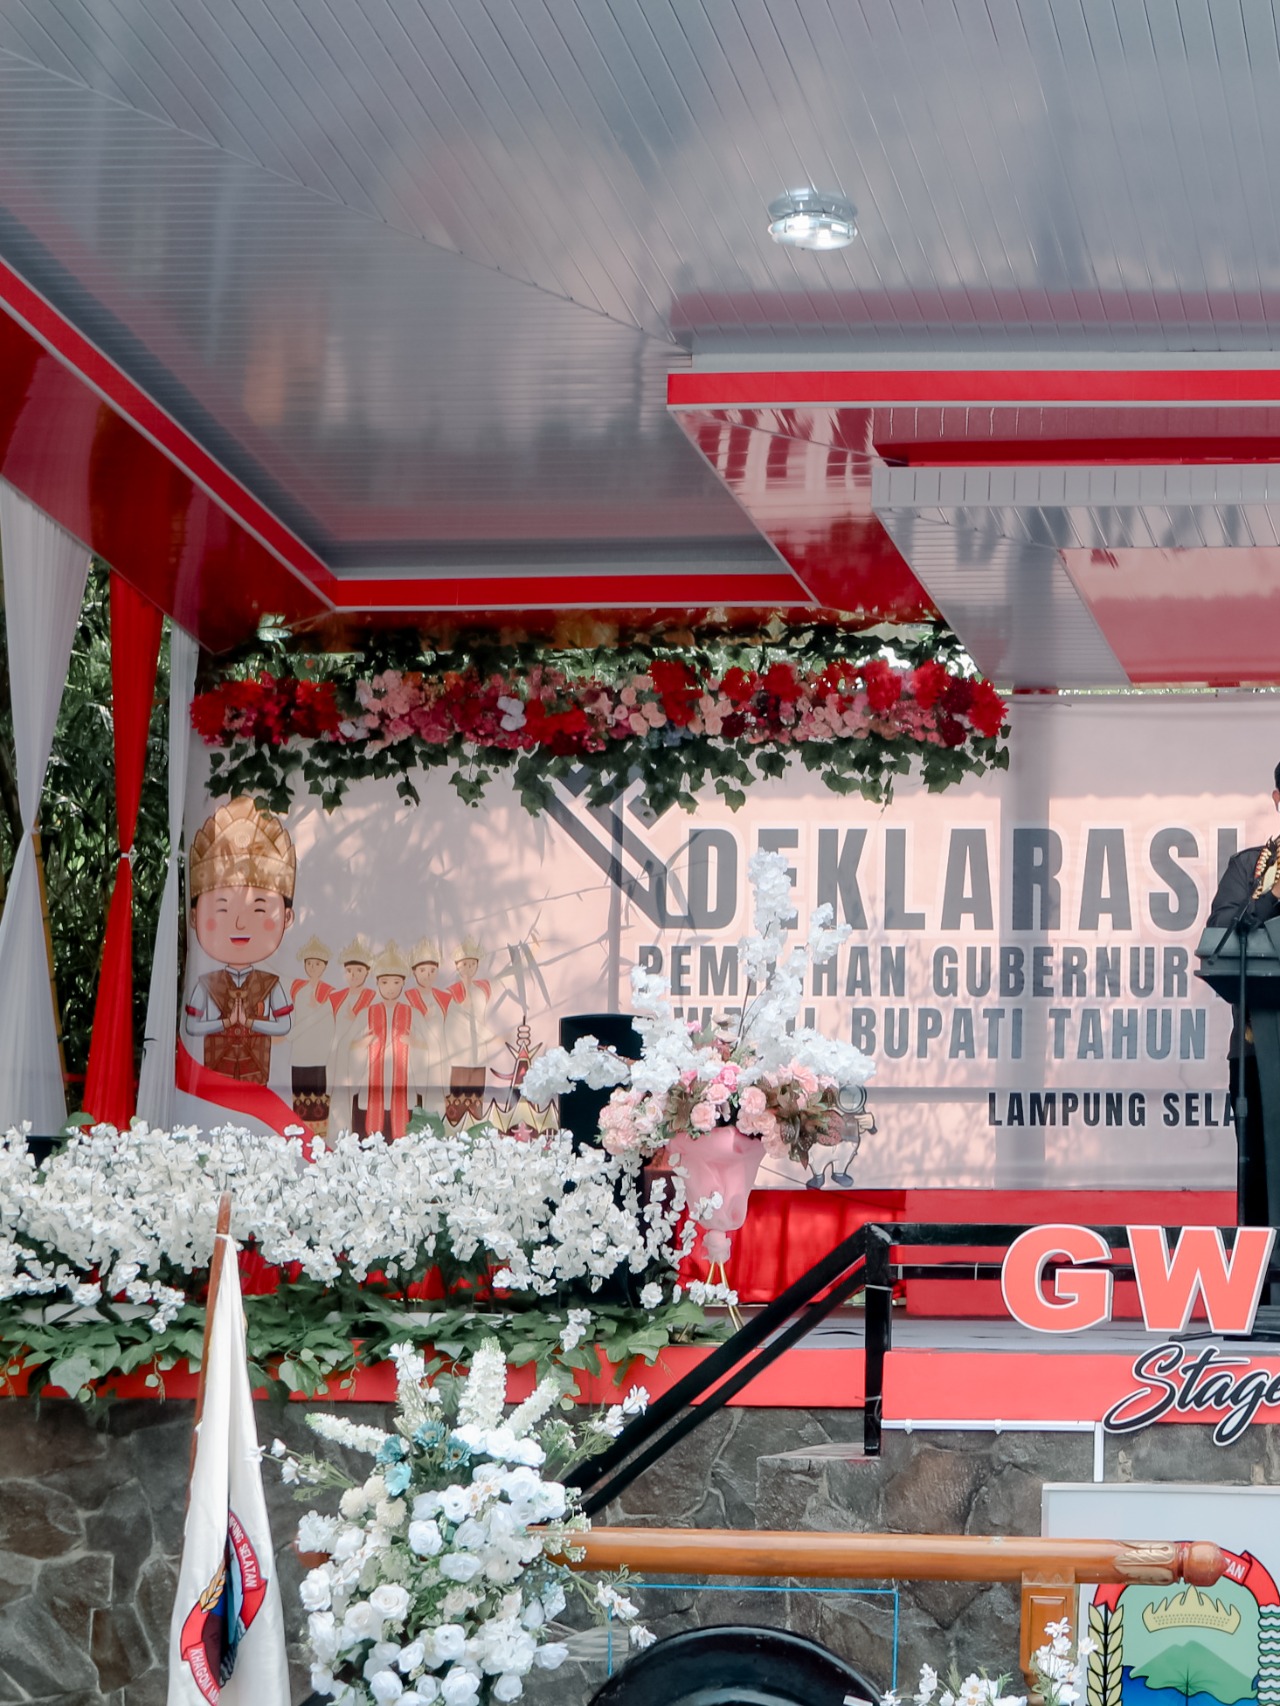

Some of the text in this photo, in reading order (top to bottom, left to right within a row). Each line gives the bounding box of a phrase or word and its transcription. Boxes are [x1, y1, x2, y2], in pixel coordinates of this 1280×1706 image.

[688, 827, 1237, 931] DEKLARAS
[638, 945, 909, 998] PEMHAN
[933, 946, 1188, 998] GUBERNUR
[851, 1007, 1023, 1060] BUPATI
[1049, 1008, 1206, 1060] TAHUN
[988, 1092, 1146, 1127] LAMPUNG
[1163, 1092, 1236, 1127] SELA
[239, 1543, 257, 1588] SELATAN
